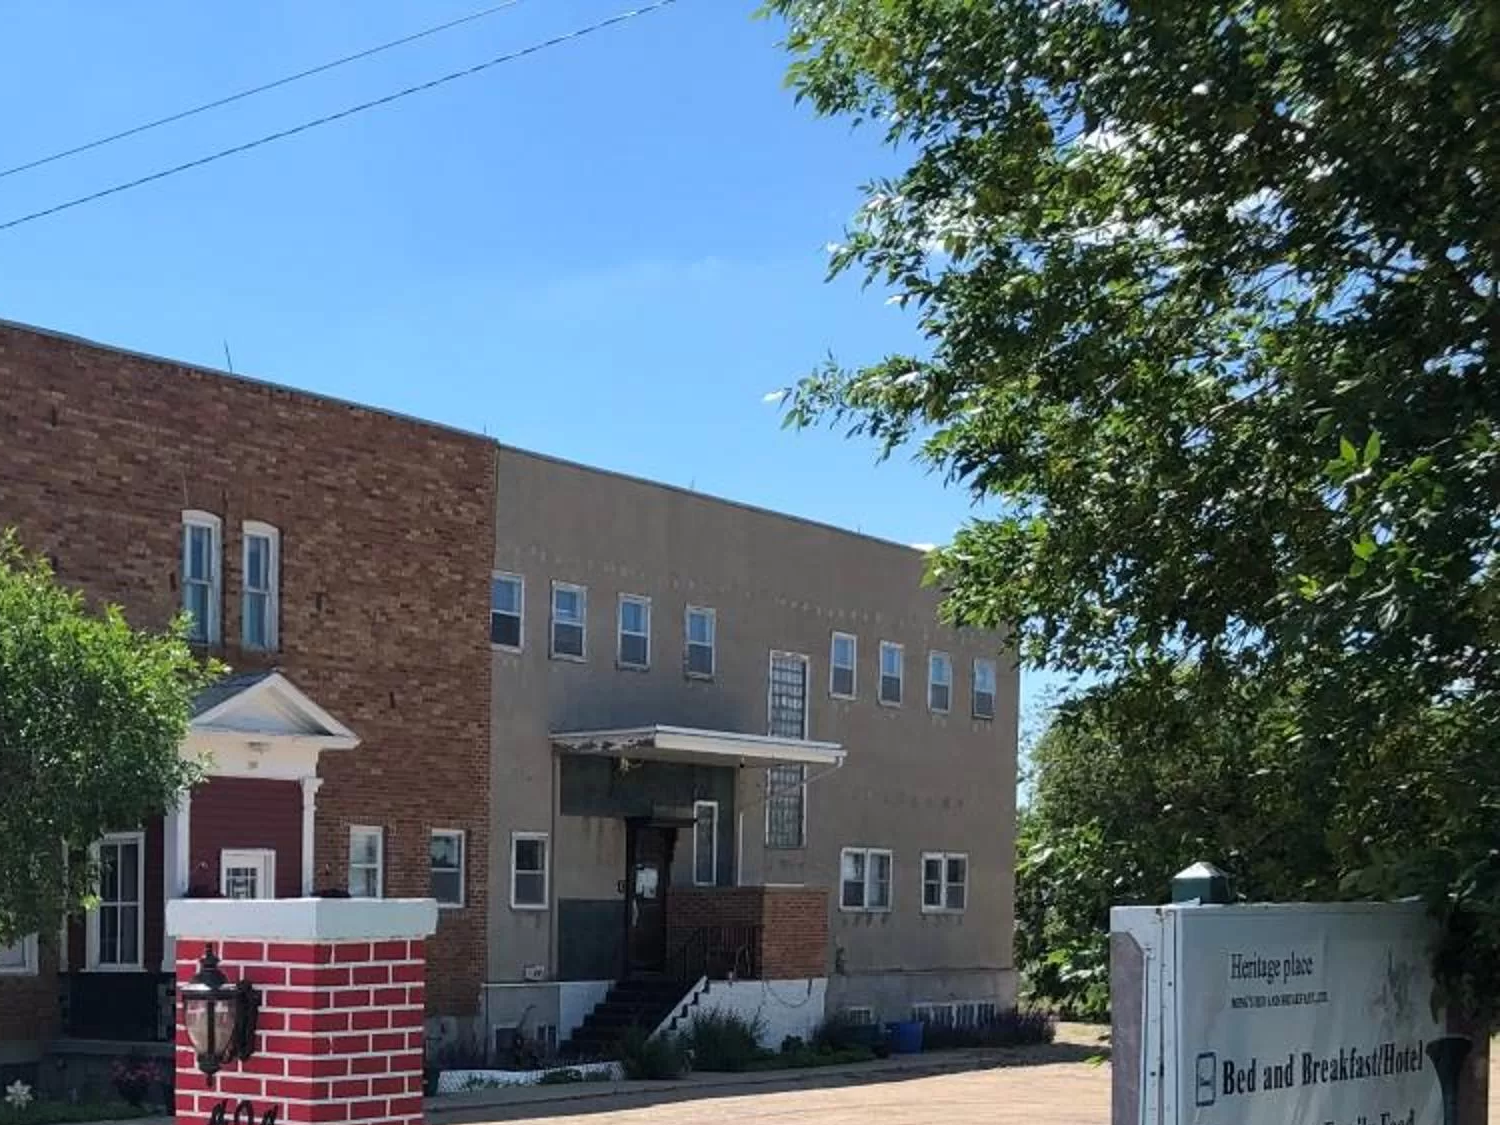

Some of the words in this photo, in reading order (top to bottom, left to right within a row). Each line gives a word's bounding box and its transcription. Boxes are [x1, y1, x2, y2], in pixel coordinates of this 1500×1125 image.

[1230, 950, 1281, 985] Heritage
[1283, 948, 1314, 985] place
[1222, 1056, 1257, 1096] Bed
[1263, 1052, 1295, 1091] and
[1301, 1039, 1424, 1086] Breakfast/Hotel
